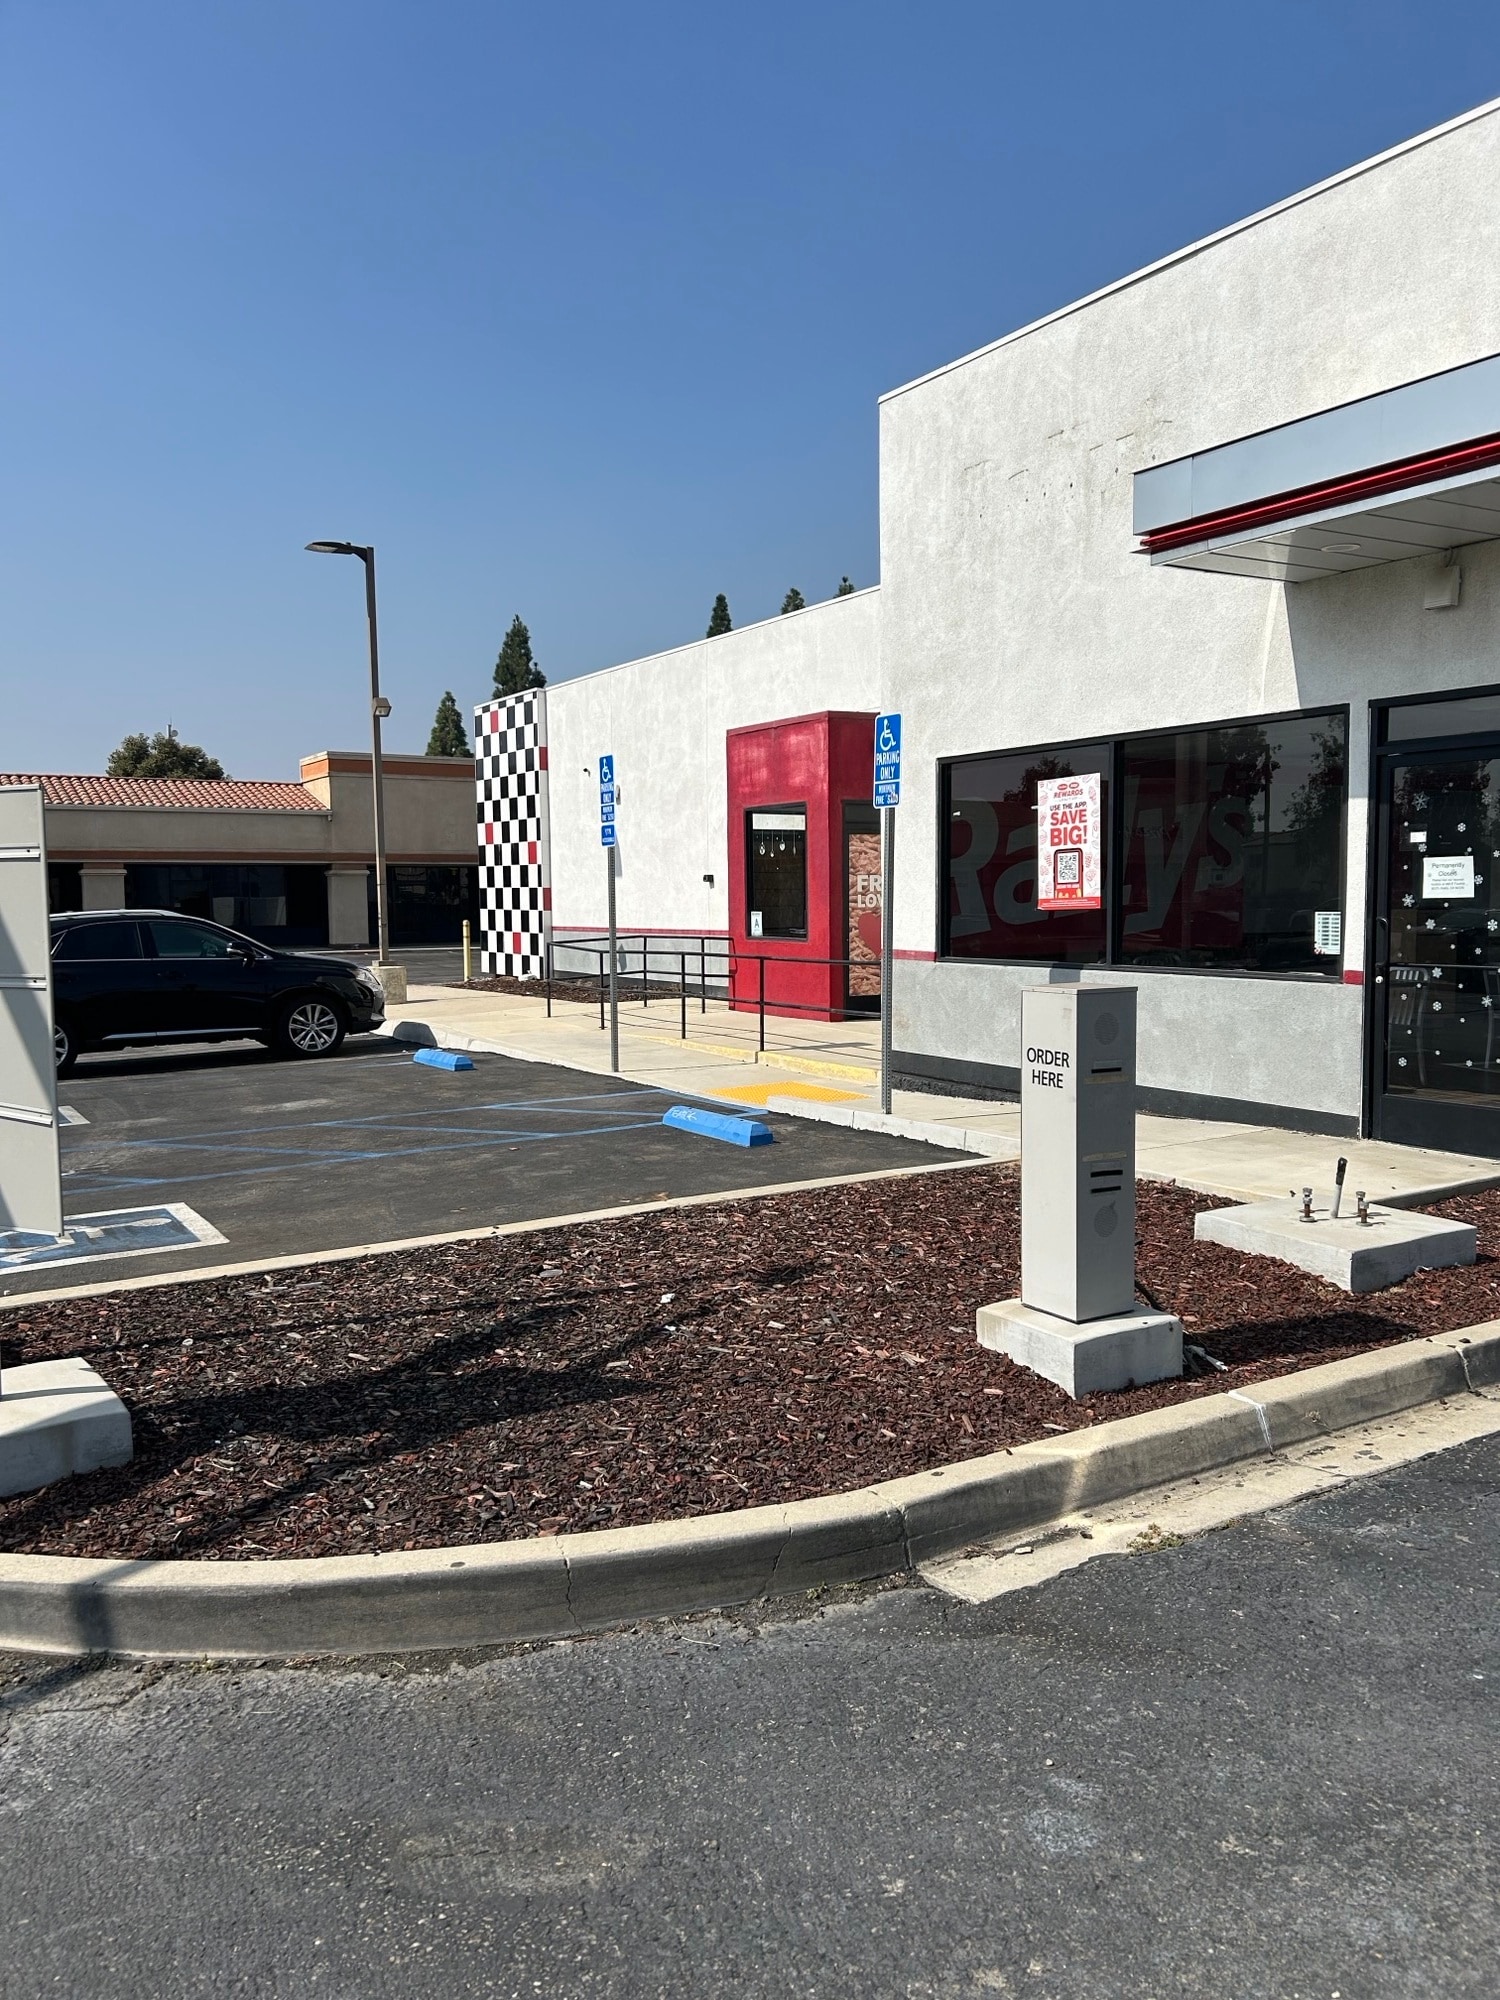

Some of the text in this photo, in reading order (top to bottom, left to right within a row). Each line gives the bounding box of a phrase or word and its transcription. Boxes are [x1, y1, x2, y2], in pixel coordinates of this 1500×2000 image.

[876, 750, 900, 766] PARKING
[880, 765, 895, 780] ONLY
[1053, 789, 1083, 798] REWARDS
[1050, 808, 1088, 826] SAVE
[1050, 825, 1087, 846] BIG!
[1026, 1047, 1070, 1068] ORDER
[1032, 1069, 1064, 1089] HERE
